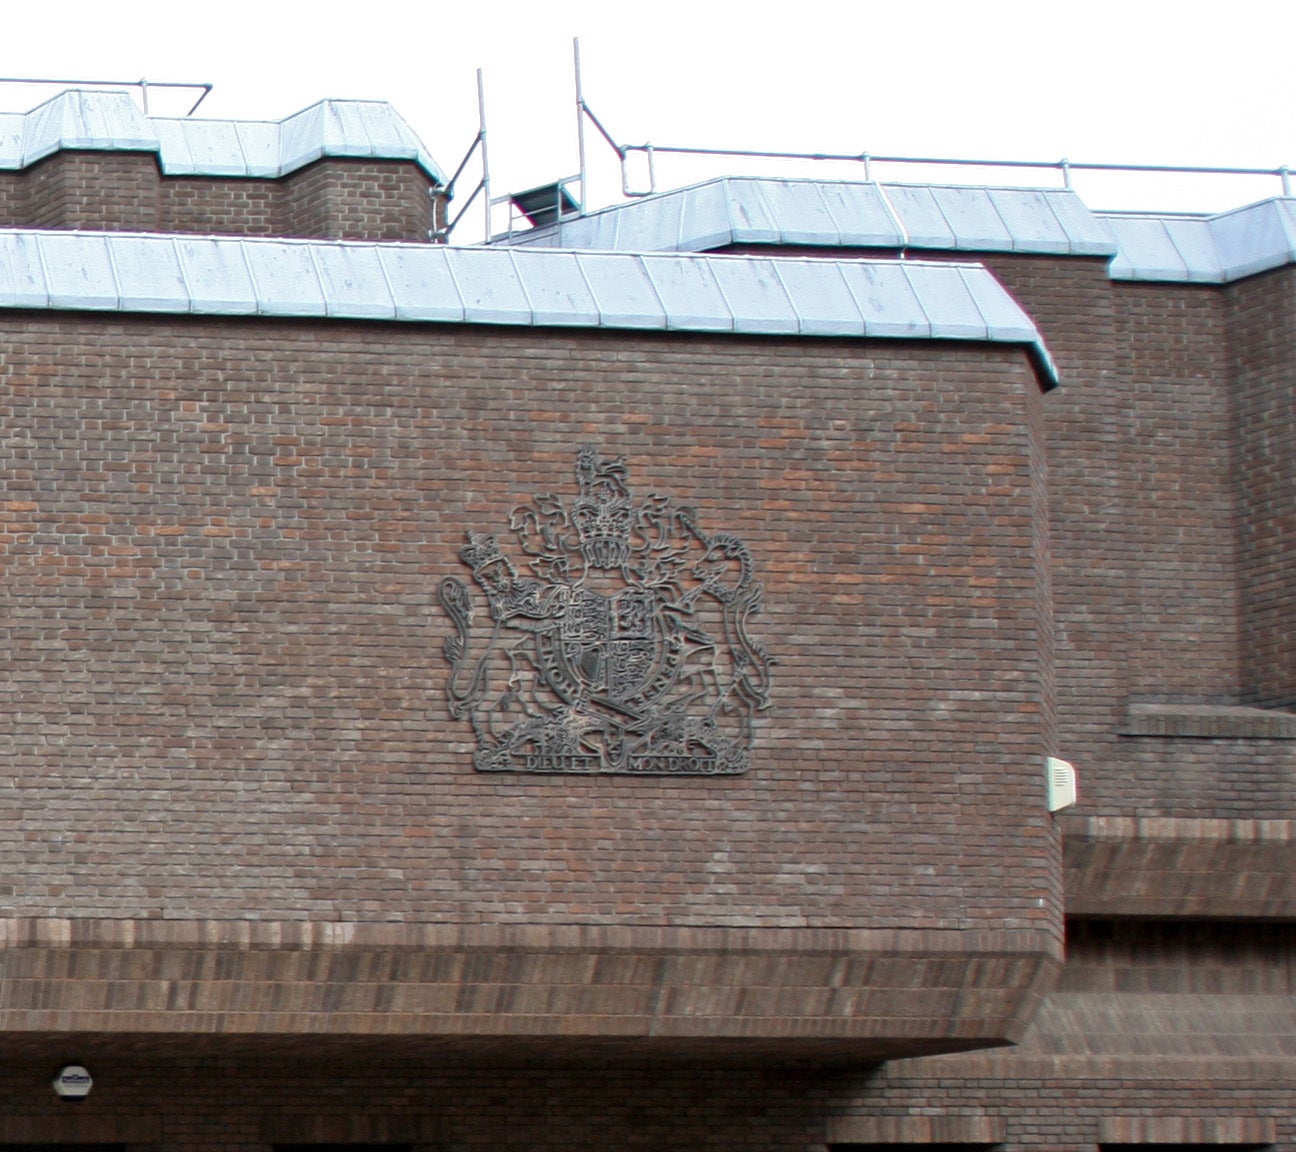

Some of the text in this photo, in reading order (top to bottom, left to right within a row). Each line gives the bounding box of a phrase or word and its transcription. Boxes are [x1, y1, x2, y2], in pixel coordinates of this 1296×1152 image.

[526, 756, 715, 771] DIEU ET MON DROIT
